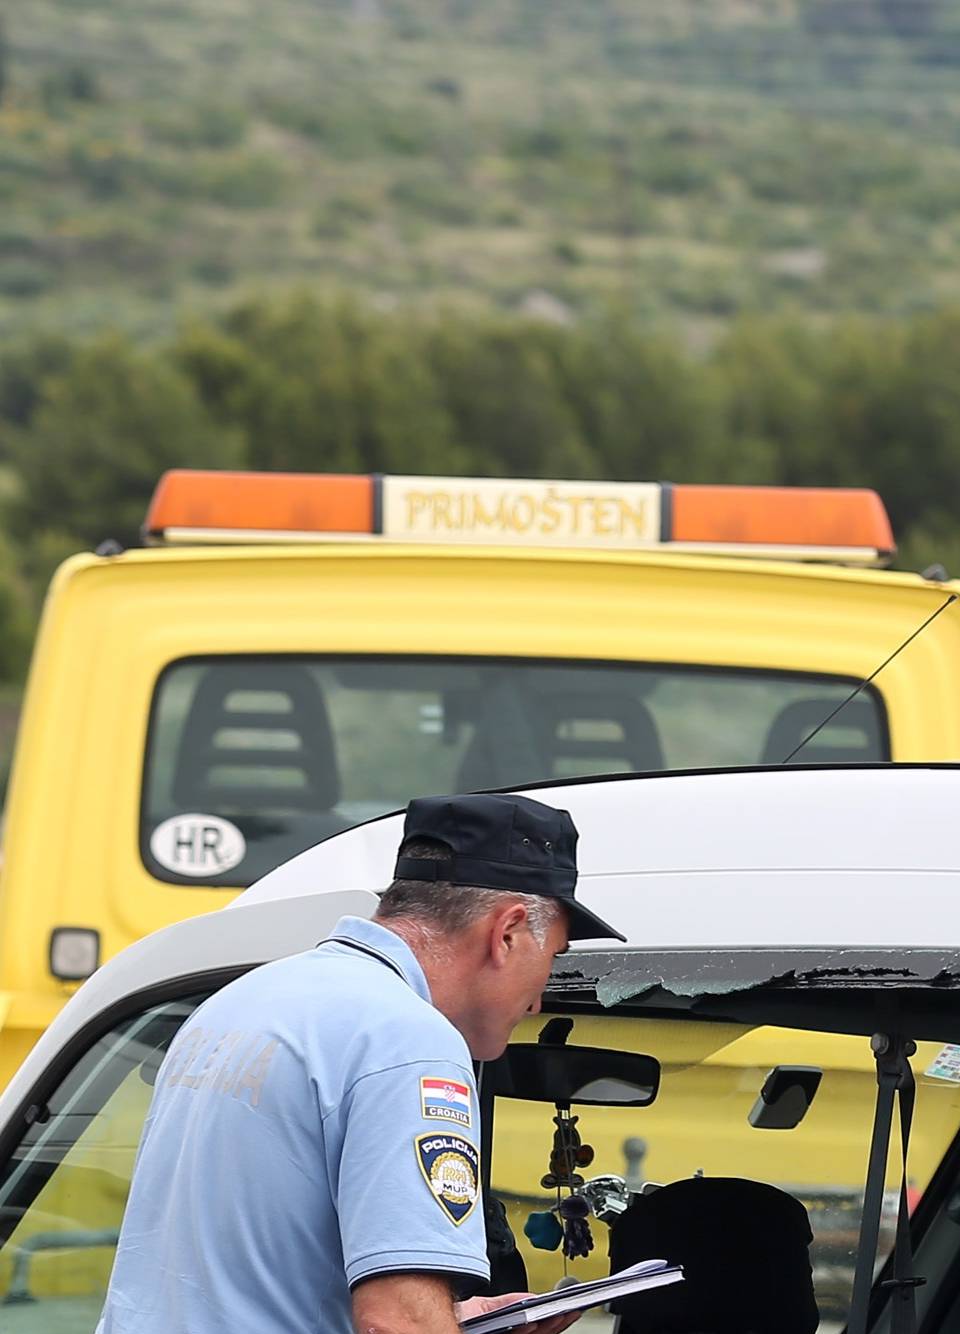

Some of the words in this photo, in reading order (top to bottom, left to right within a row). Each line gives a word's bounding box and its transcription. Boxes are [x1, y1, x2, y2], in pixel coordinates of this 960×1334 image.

[404, 482, 648, 536] PRIMOŠTEN
[173, 826, 222, 864] HR
[429, 1107, 468, 1123] CROATIA
[422, 1138, 478, 1166] POLICIJA
